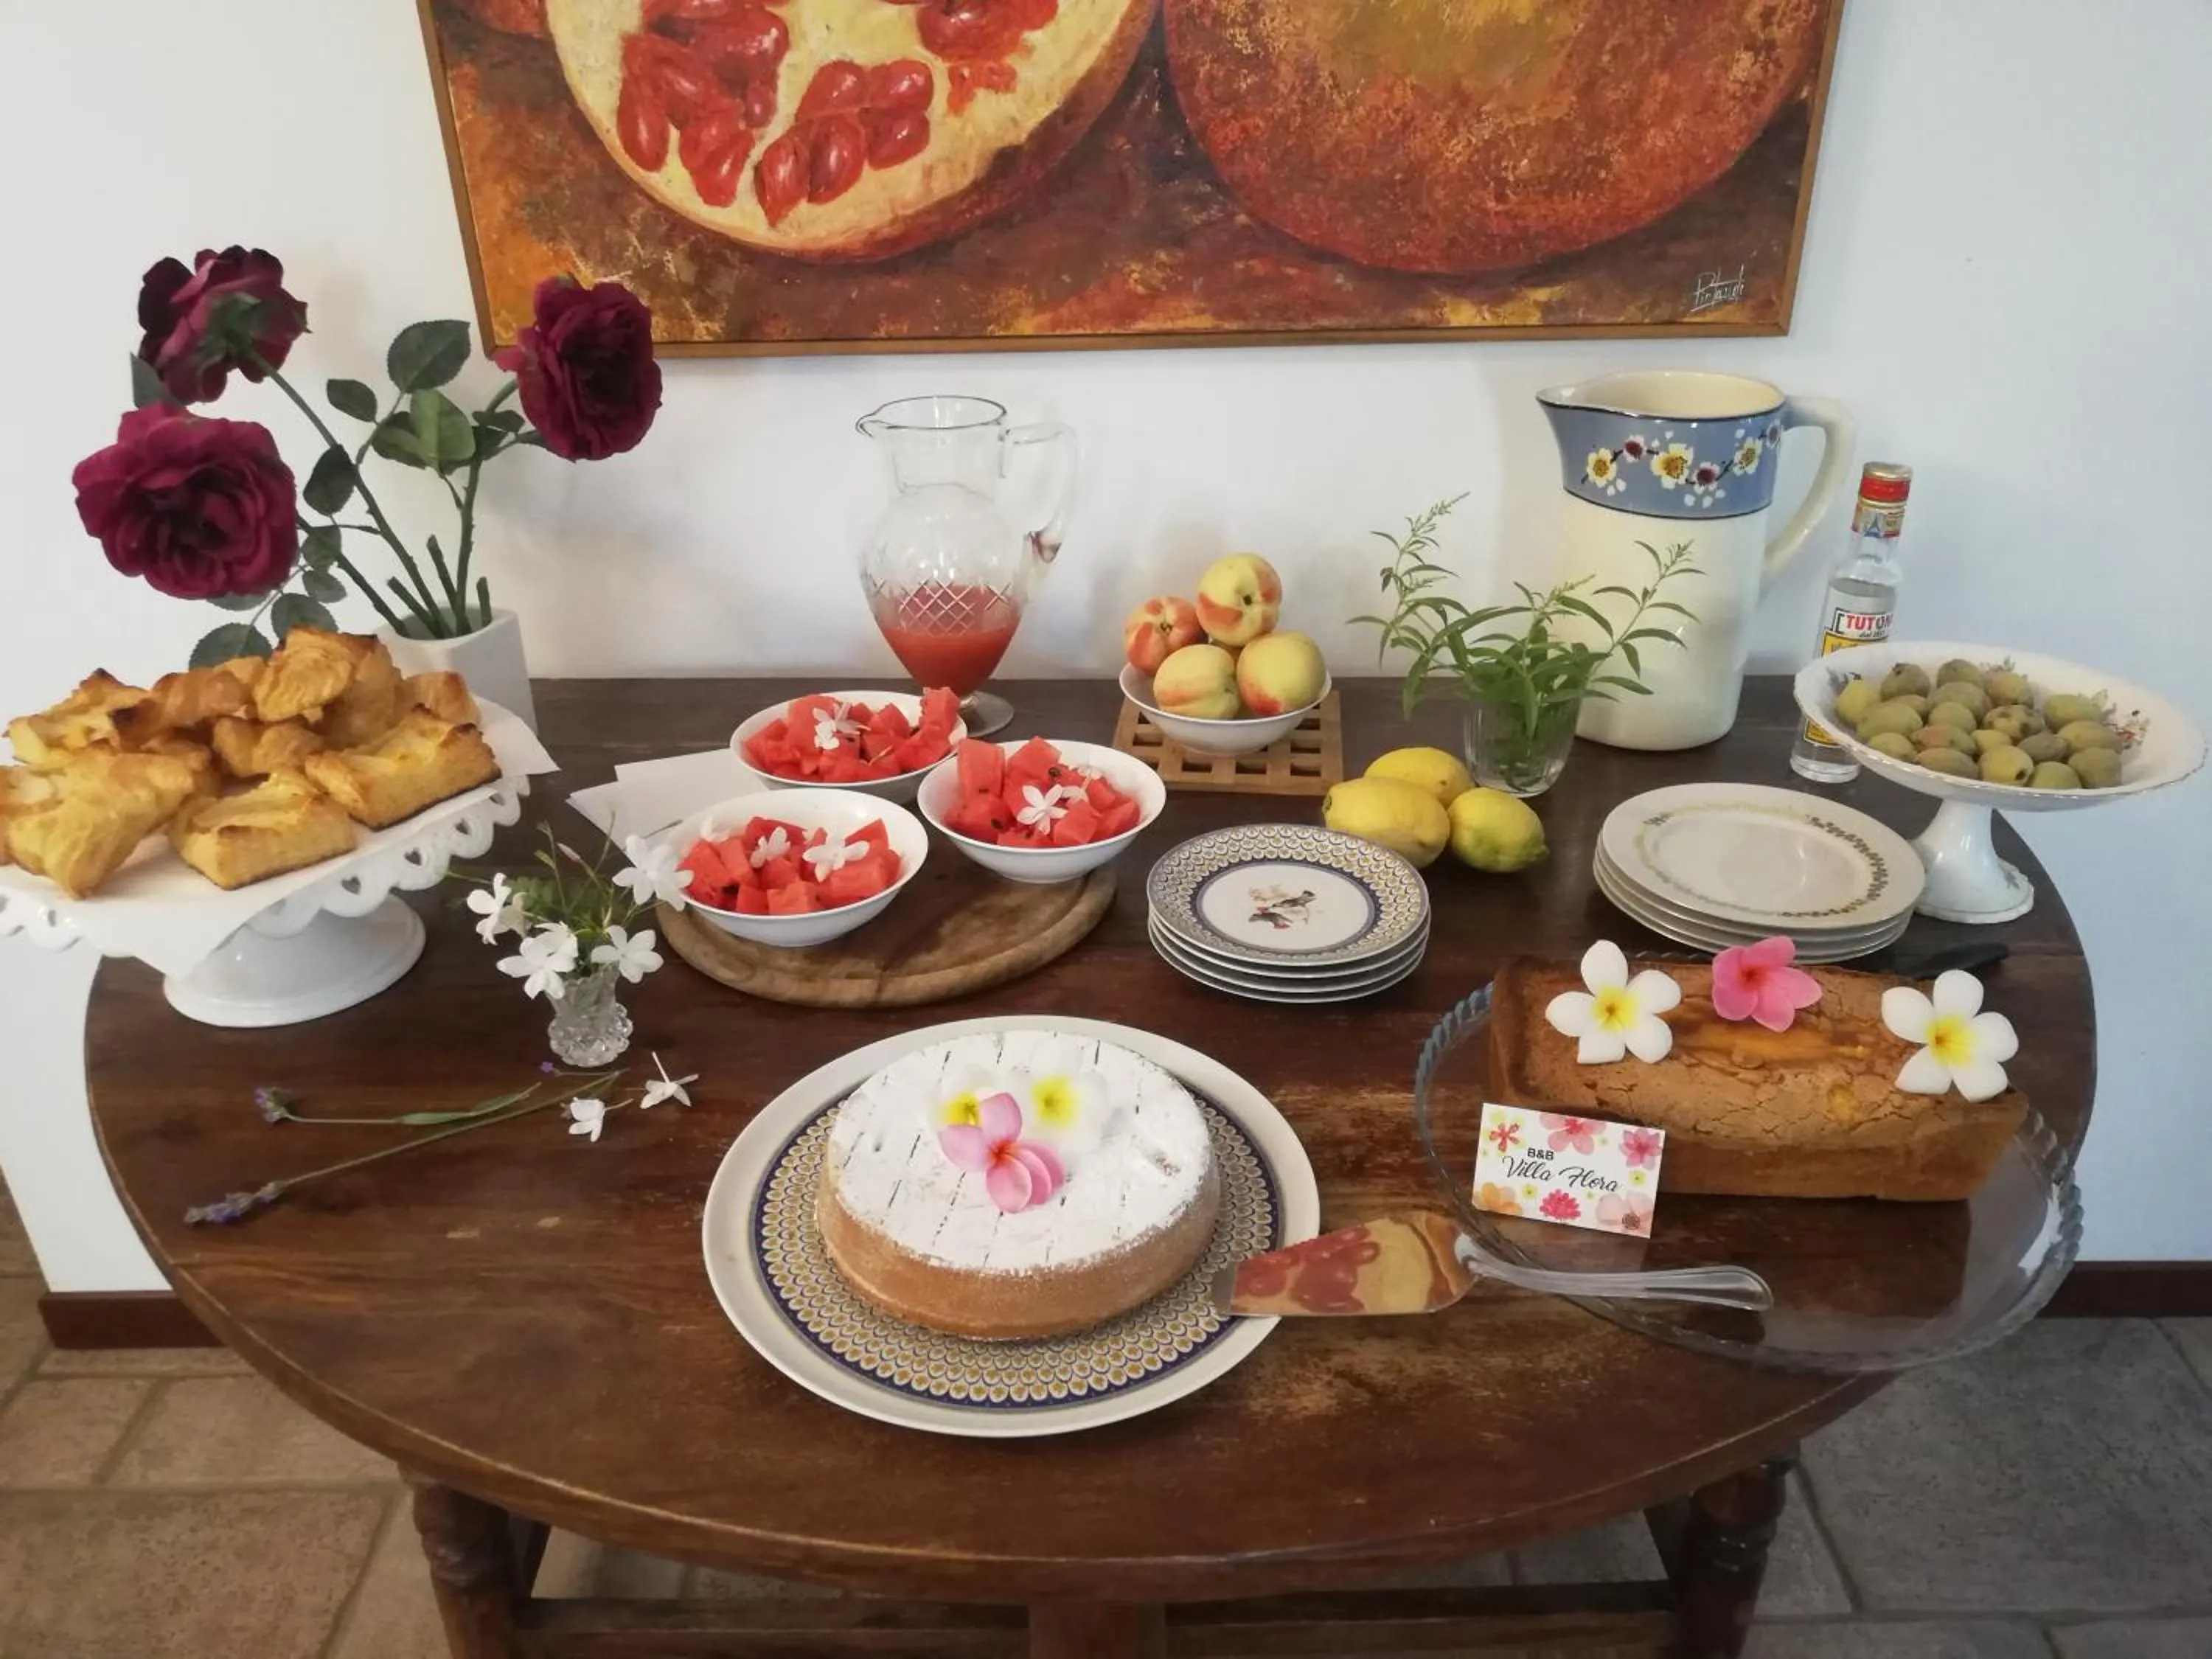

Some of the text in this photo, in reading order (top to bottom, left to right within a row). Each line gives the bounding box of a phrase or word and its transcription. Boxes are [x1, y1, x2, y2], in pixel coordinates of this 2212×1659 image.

[1527, 1147, 1554, 1161] B&B
[1502, 1155, 1618, 1192] Villa Flora
